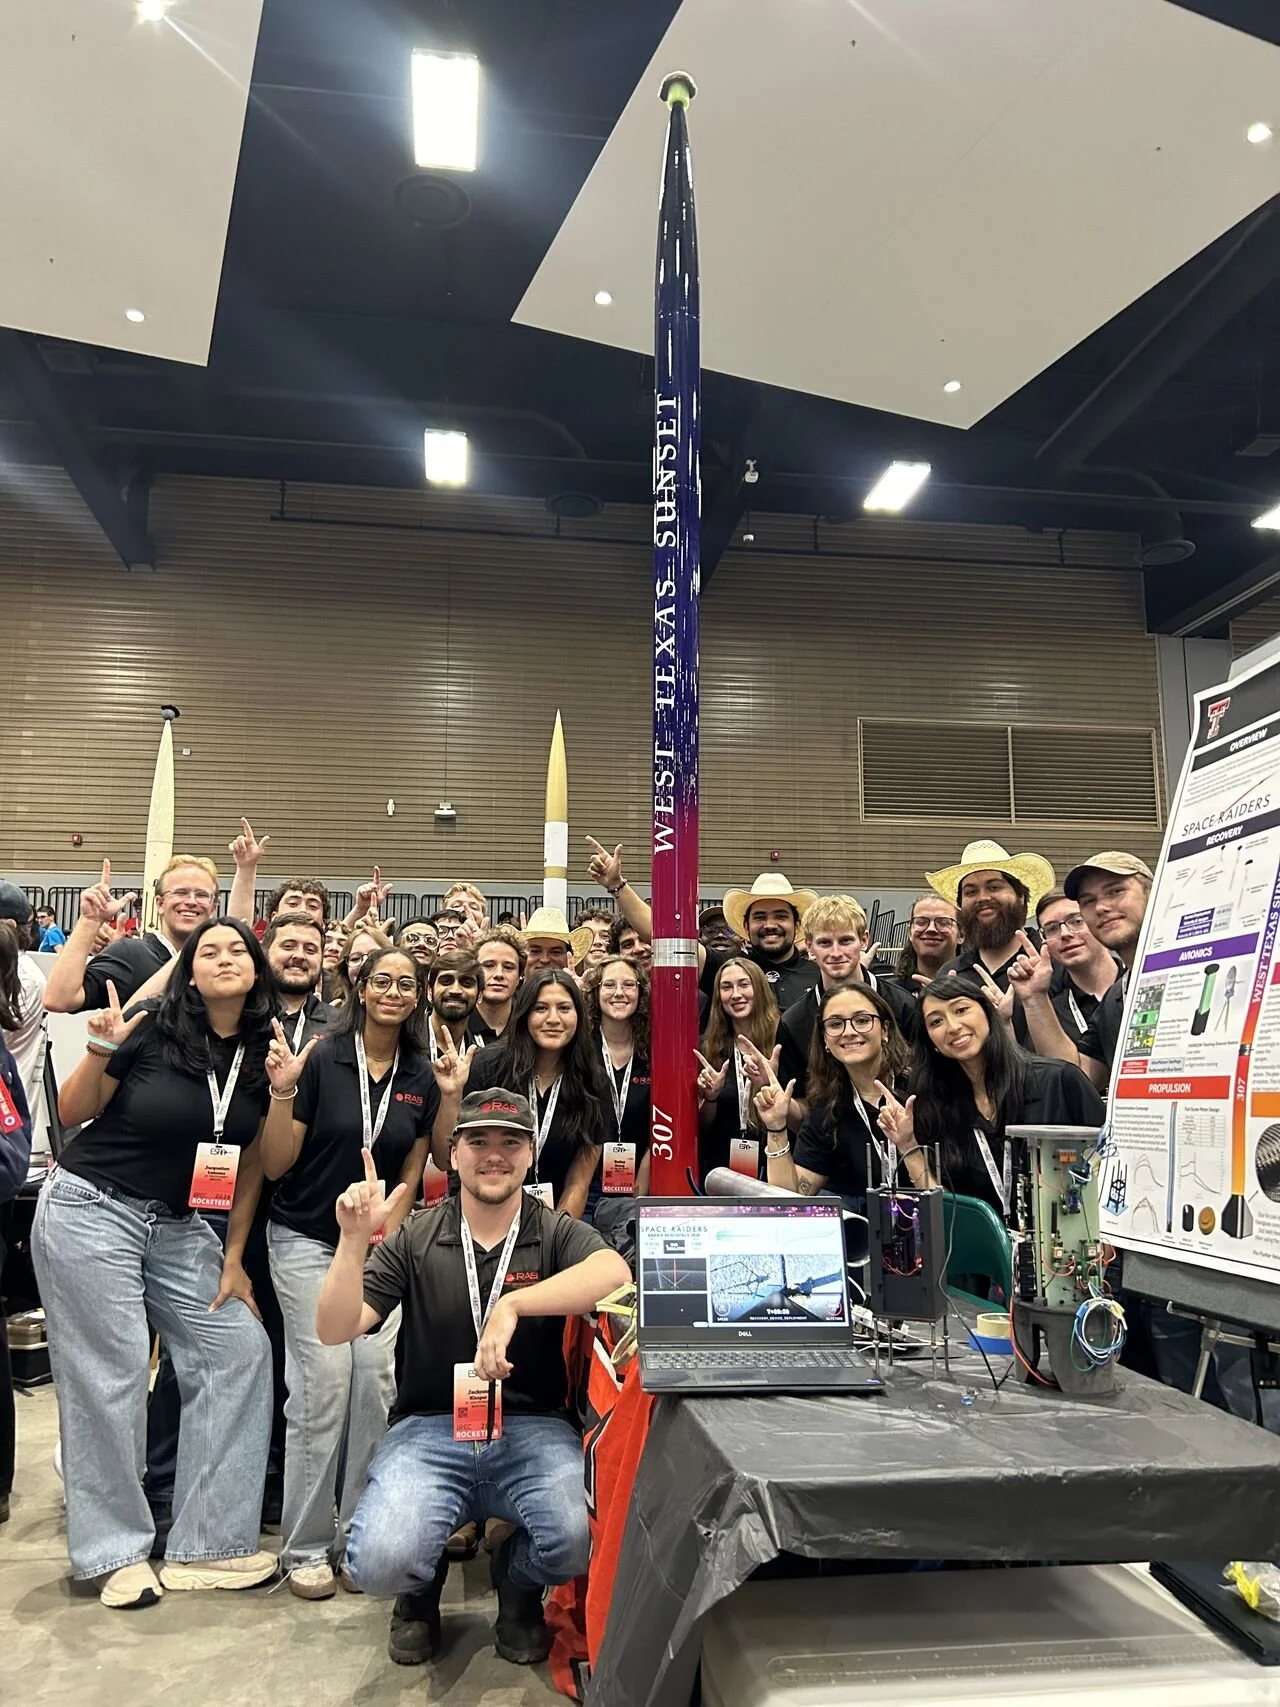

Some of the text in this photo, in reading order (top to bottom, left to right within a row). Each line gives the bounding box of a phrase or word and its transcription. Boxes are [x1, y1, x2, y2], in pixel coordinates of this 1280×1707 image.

[654, 393, 677, 855] WEST TEXAS SUNSET
[1229, 728, 1268, 752] OVERVIEW
[1181, 794, 1271, 837] SPACE RAIDERS
[1206, 825, 1243, 846] RECOVERY
[1179, 946, 1213, 962] AVIONICS
[1252, 962, 1270, 1004] WEST
[1262, 911, 1279, 961] TEXAS
[1148, 1083, 1191, 1094] PROPULSION
[1236, 1078, 1246, 1101] 307
[404, 1093, 424, 1103] RAS
[491, 1102, 518, 1113] RAS
[652, 1104, 673, 1161] 307
[191, 1197, 231, 1206] ROCKETEER
[516, 1272, 539, 1280] RAS
[456, 1429, 499, 1439] ROCKETR
